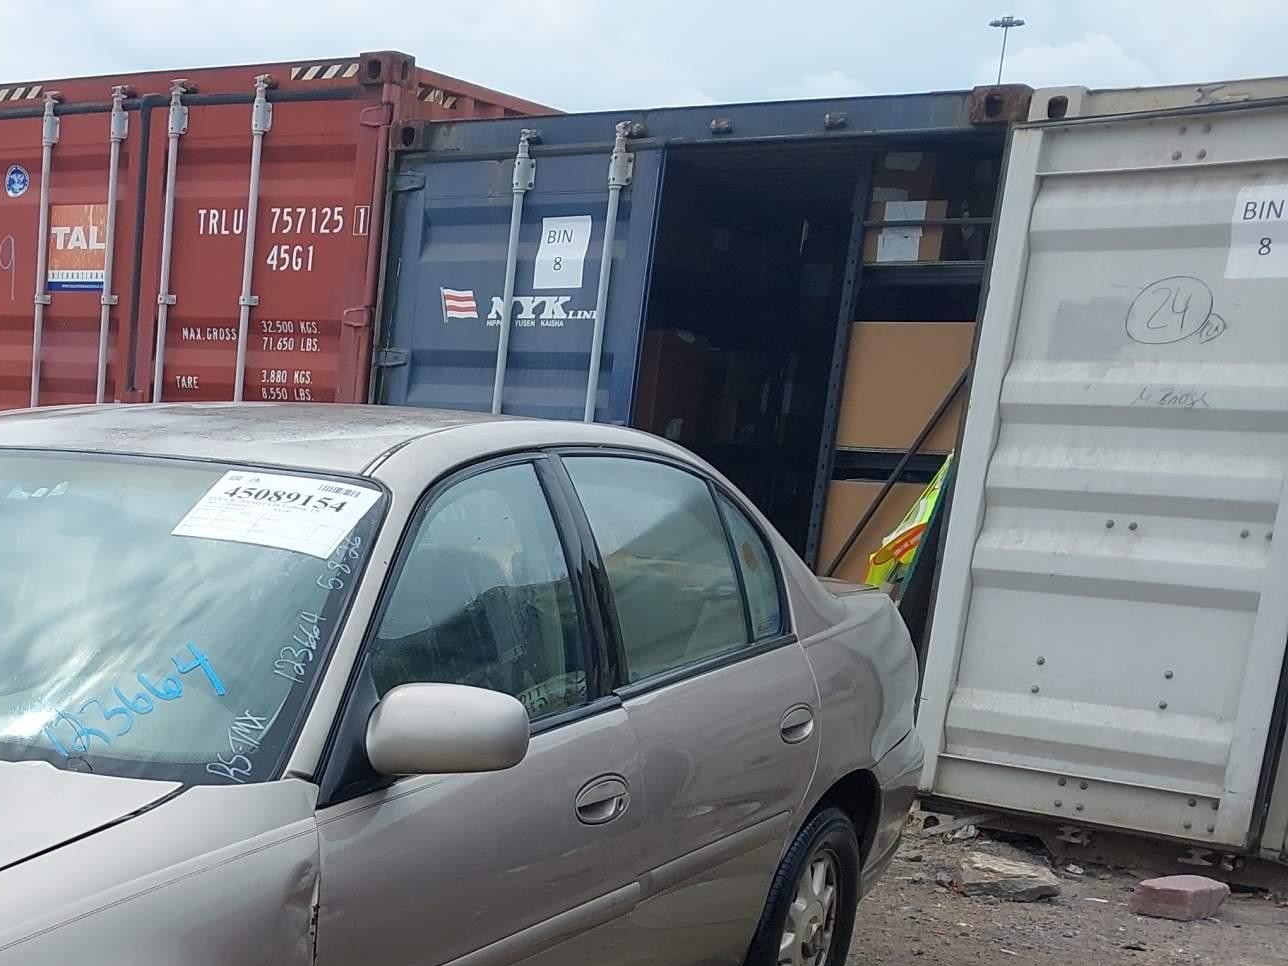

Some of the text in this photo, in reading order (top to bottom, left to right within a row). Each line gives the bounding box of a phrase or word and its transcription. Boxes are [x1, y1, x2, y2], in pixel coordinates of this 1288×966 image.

[1242, 199, 1285, 221] BIN
[198, 208, 244, 235] TRLU
[270, 206, 344, 234] 757125
[51, 225, 106, 250] TAL
[547, 229, 574, 244] BIN
[1257, 237, 1273, 256] 8
[266, 244, 314, 272] 45G1
[553, 256, 562, 271] 8
[487, 296, 571, 319] NYK
[261, 320, 321, 334] 32.500 KGS.
[515, 319, 536, 328] YUSEN
[540, 319, 564, 328] KAISHA
[262, 336, 321, 352] 71.650 LBS.
[175, 375, 199, 389] TARE
[261, 369, 313, 384] 3.880 KGS.
[295, 388, 314, 401] LBS.
[223, 486, 349, 513] 45089154
